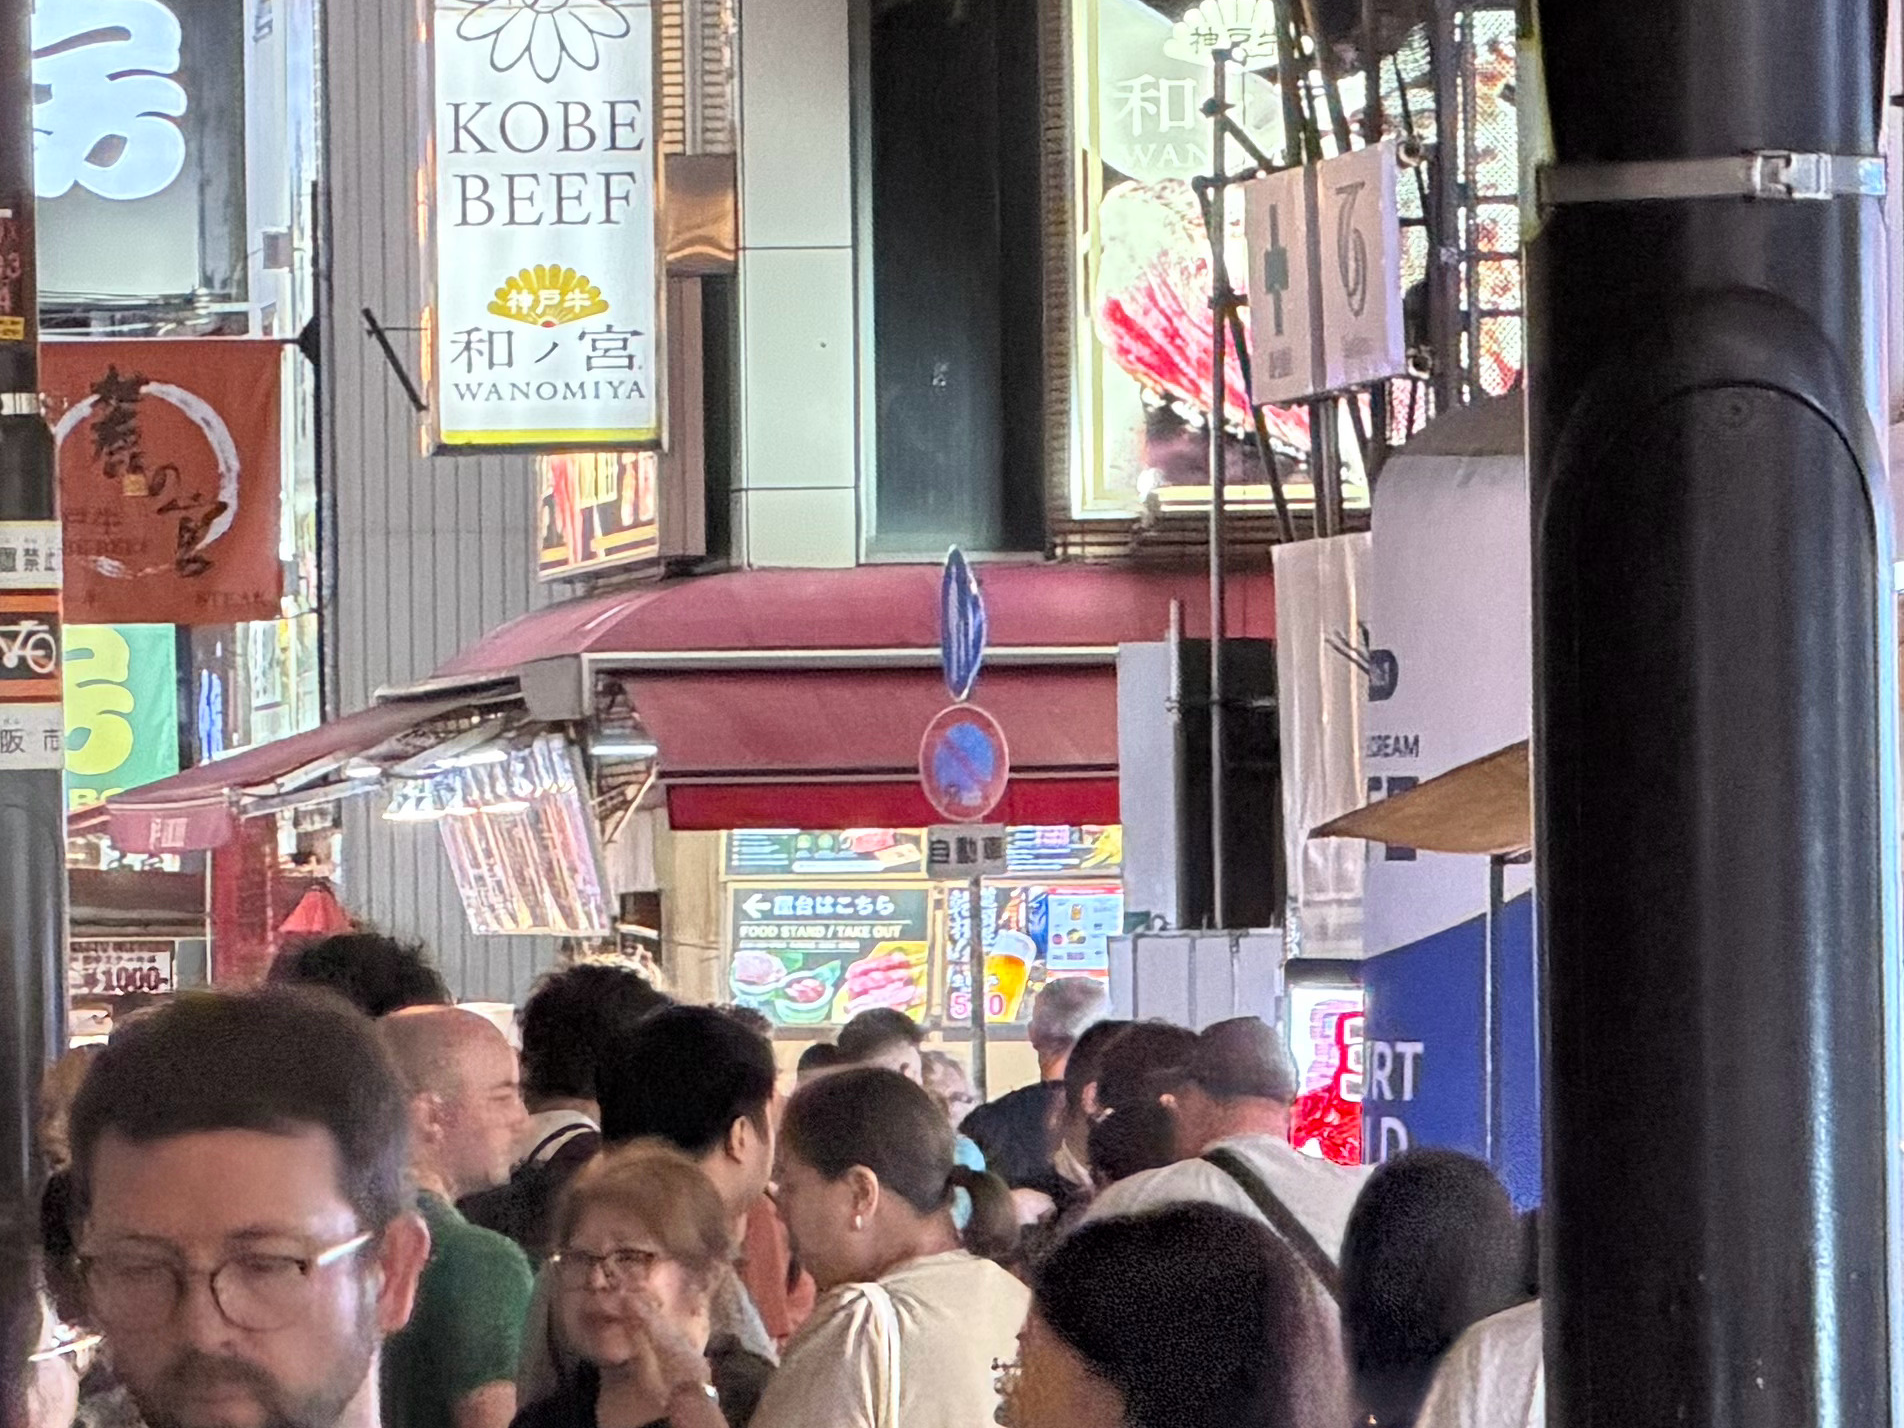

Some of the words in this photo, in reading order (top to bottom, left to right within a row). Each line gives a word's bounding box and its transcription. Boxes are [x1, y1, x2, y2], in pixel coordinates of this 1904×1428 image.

[445, 100, 645, 155] KOBE
[453, 170, 639, 227] BEEF
[507, 288, 592, 315] 神戸牛
[449, 325, 644, 374] 和ノ宮
[452, 380, 647, 402] WANOMIYA
[739, 925, 778, 939] FOOD
[949, 992, 1005, 1019] 50
